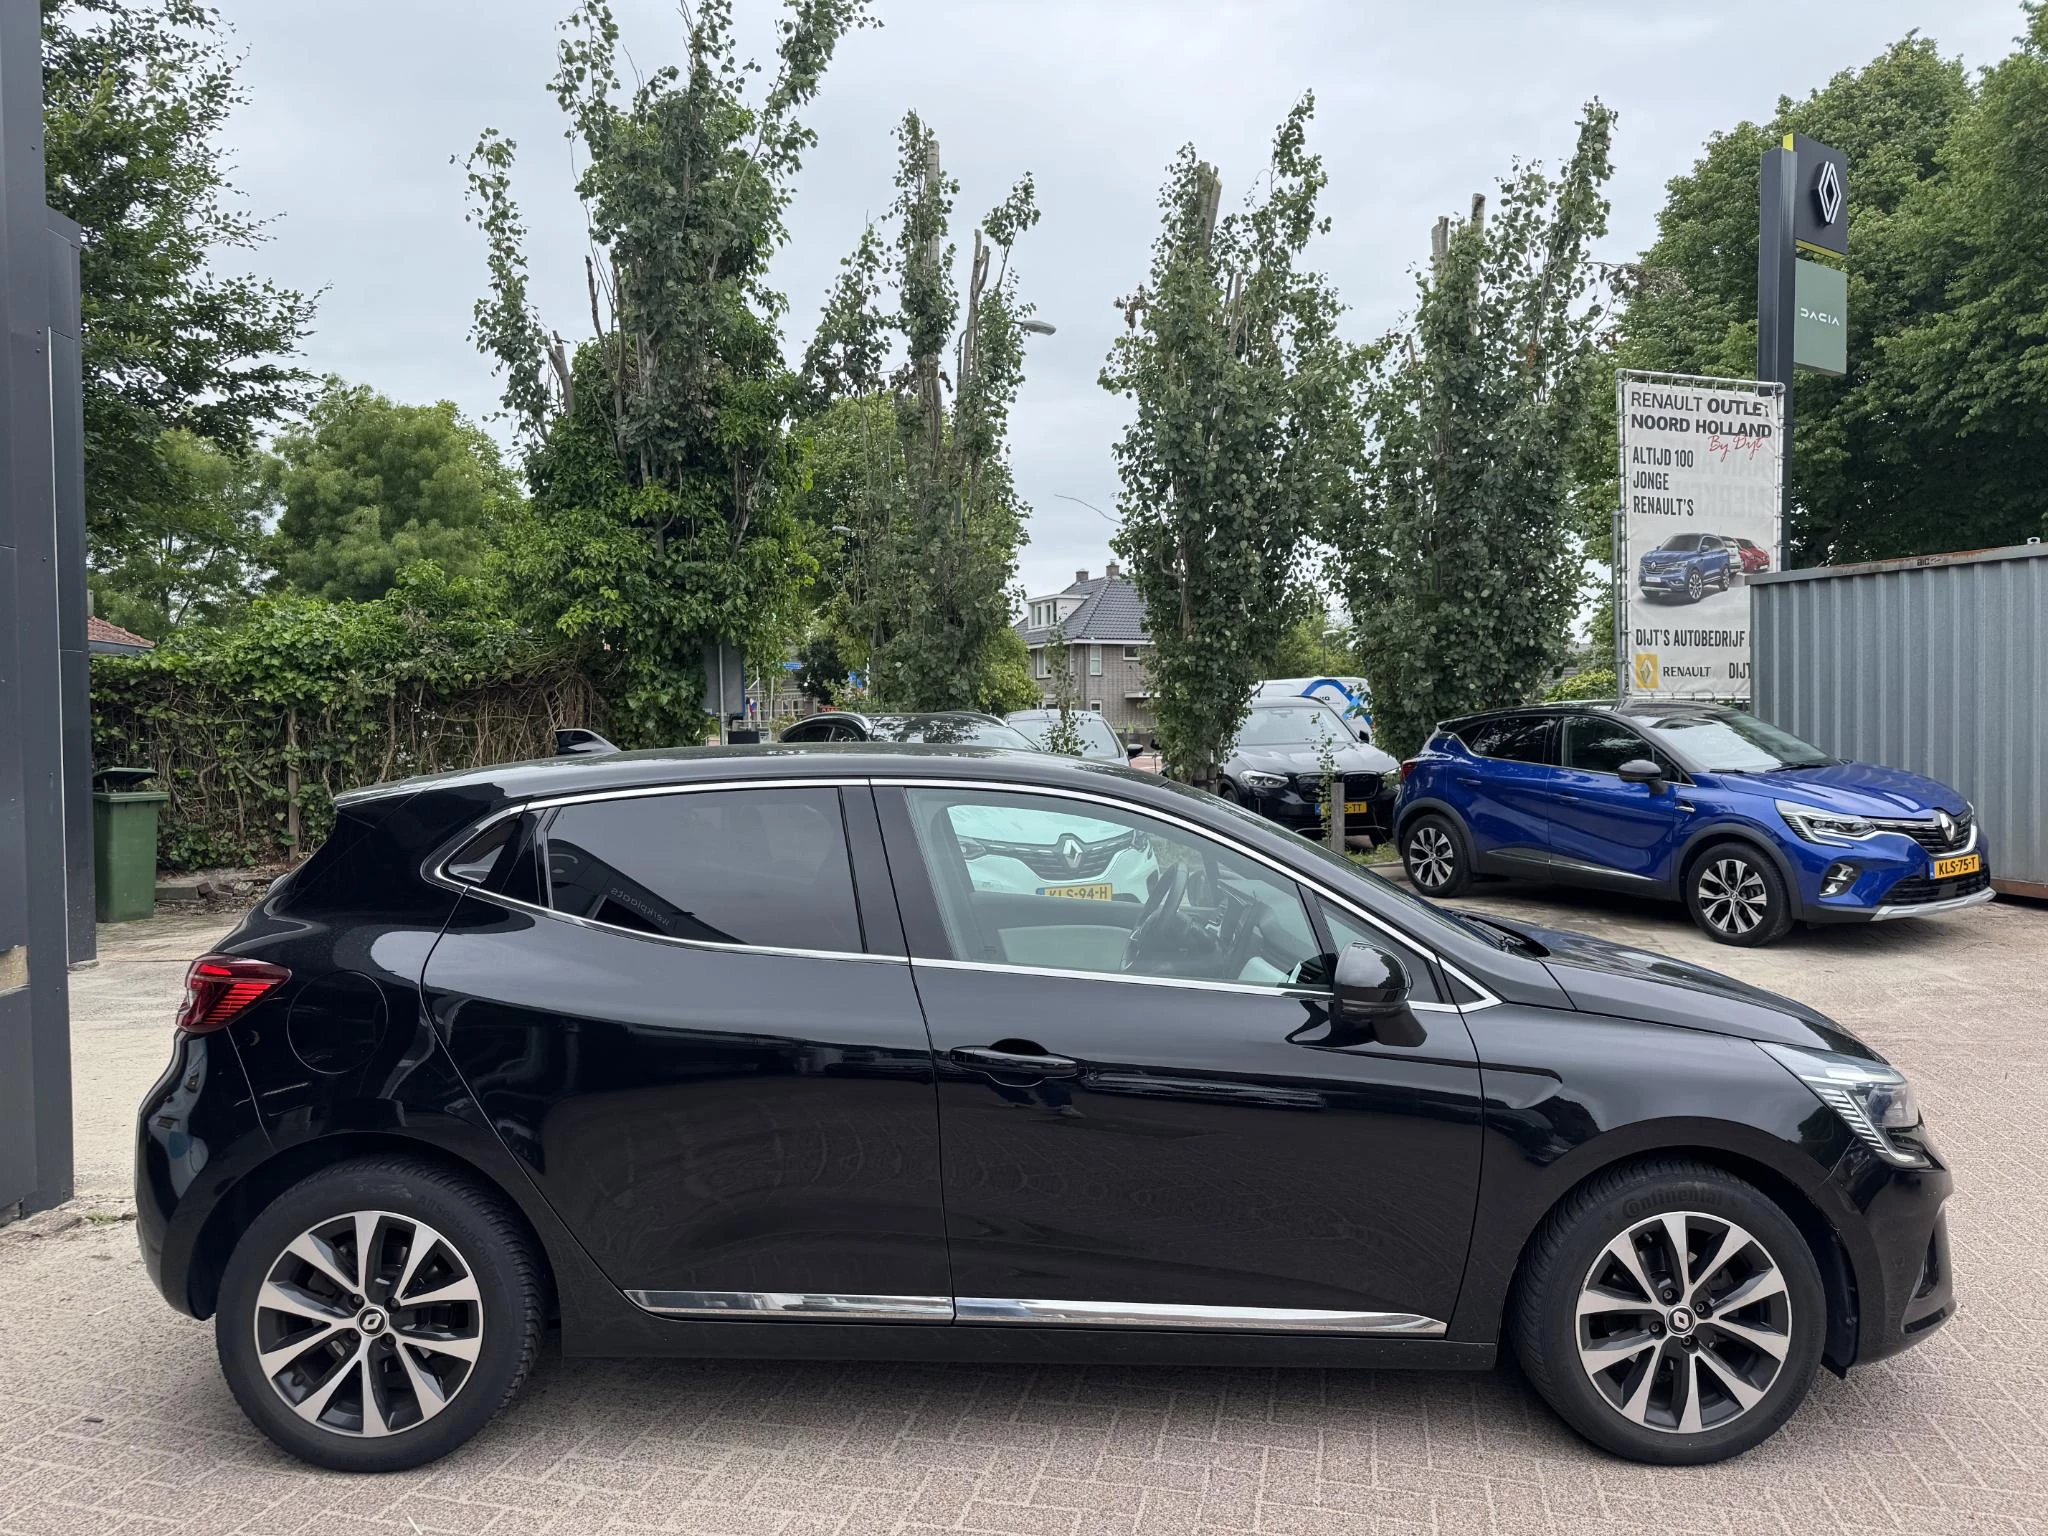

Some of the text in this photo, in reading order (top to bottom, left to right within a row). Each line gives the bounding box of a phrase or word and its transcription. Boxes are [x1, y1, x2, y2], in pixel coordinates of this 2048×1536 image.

[1800, 307, 1840, 326] DACIA
[1631, 391, 1703, 412] RENAULT
[1631, 414, 1772, 438] NOORD HOLLAND
[1633, 446, 1672, 466] ALTIJD
[1675, 450, 1694, 468] 100
[1708, 435, 1730, 462] By
[1633, 471, 1669, 490] JONGE
[1633, 496, 1694, 516] RENAULT'S
[1635, 629, 1670, 646] DIJT'S
[1673, 629, 1746, 647] AUTOBEDRIJF
[1662, 666, 1711, 677] RENAULT
[1938, 857, 1976, 876] KLS-75-T
[1622, 1187, 1724, 1218] Continental
